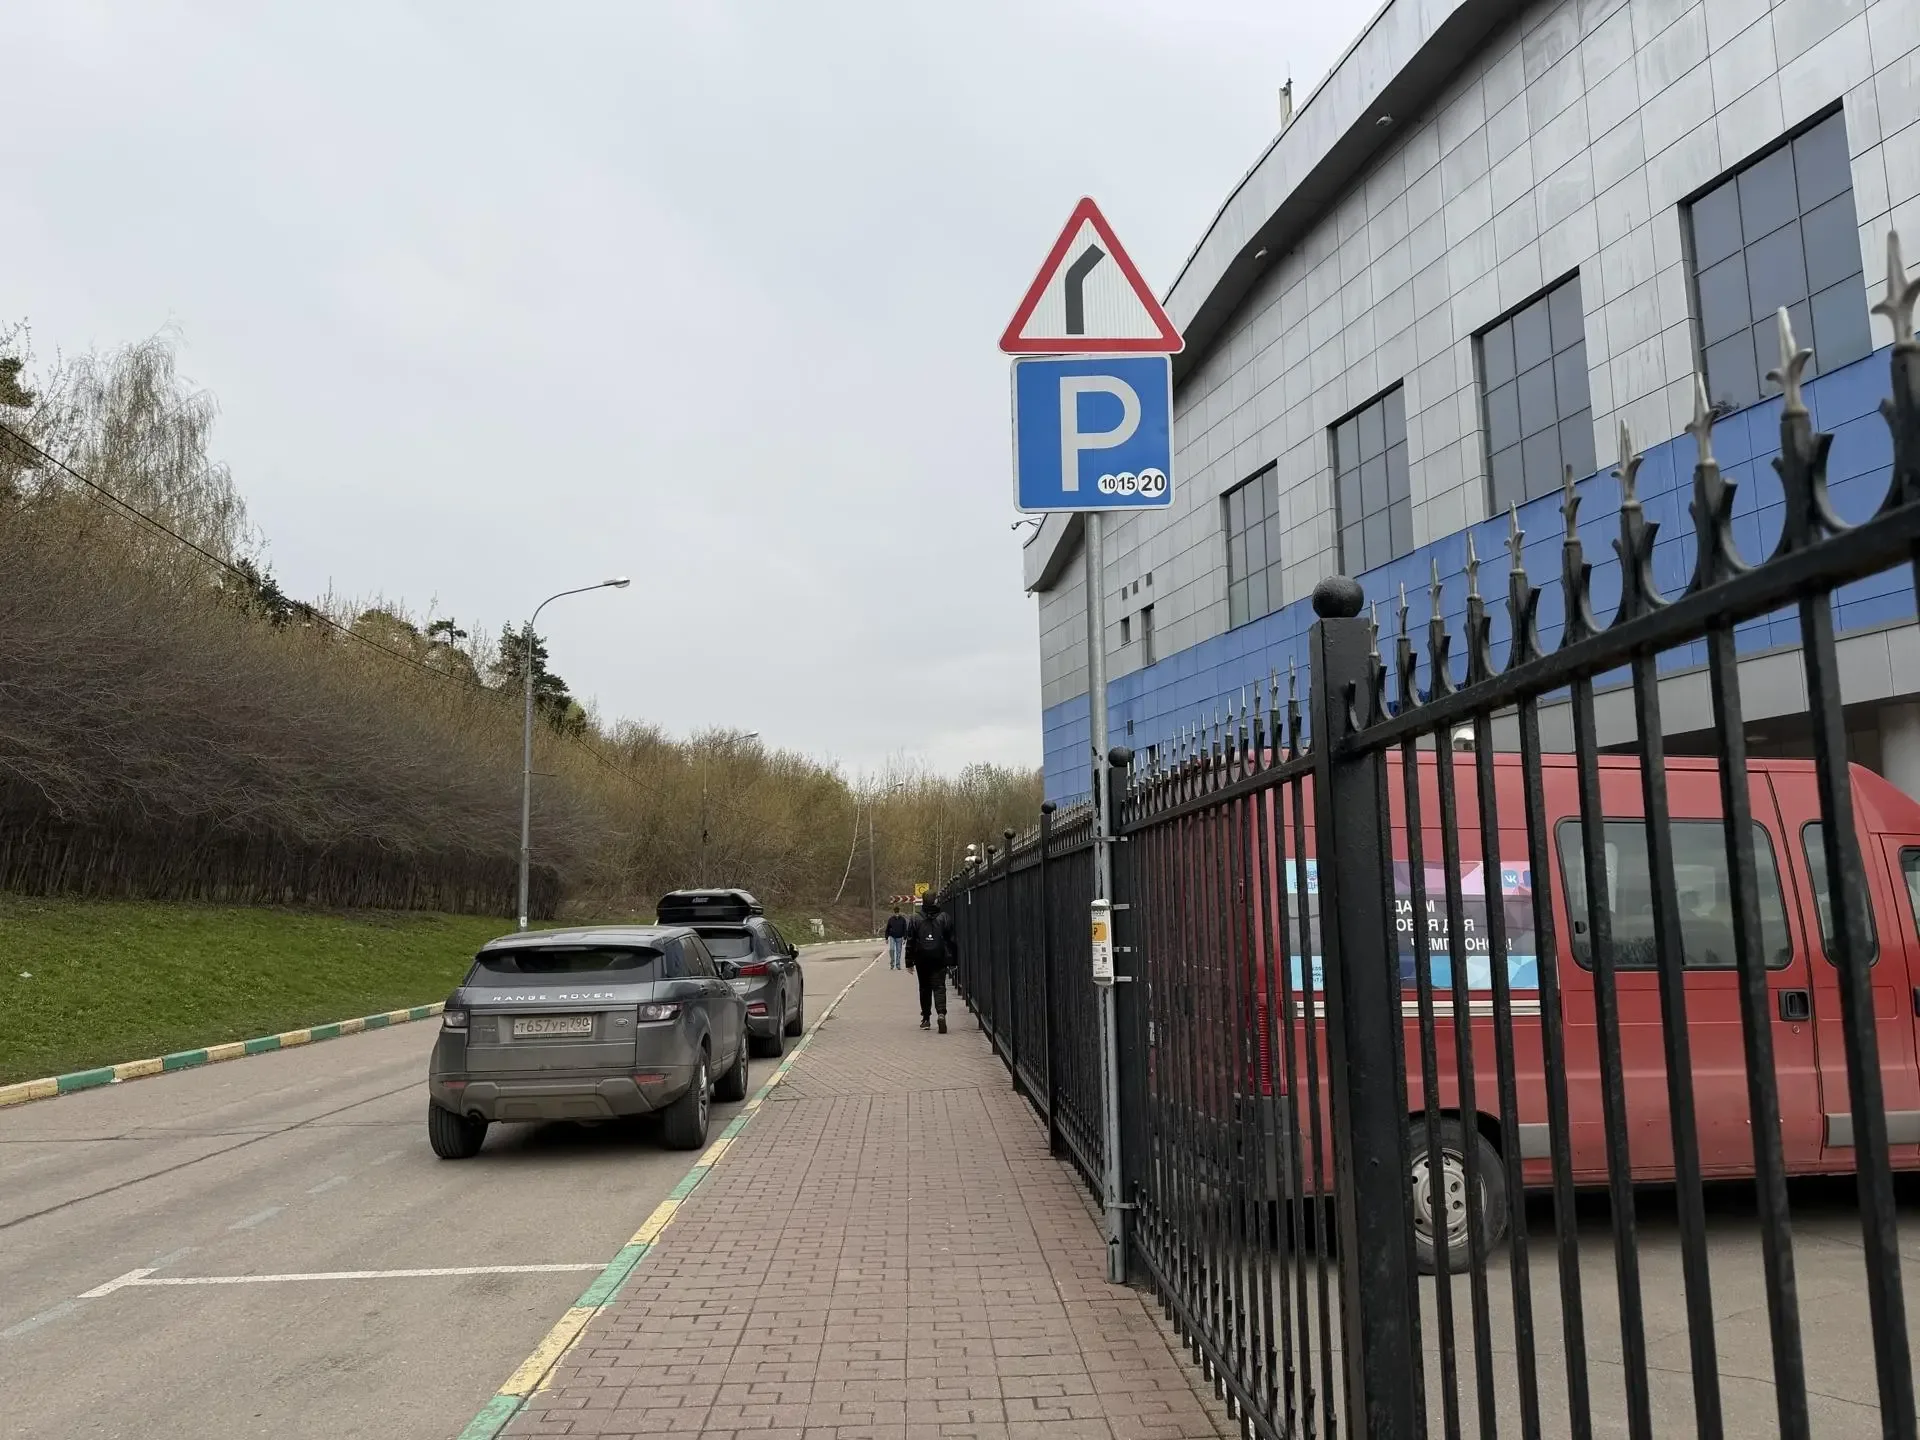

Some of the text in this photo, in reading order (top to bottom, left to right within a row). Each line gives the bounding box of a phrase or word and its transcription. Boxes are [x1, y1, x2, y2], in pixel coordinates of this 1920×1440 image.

[1060, 375, 1142, 492] P
[1101, 474, 1166, 492] 10 15 20
[559, 992, 616, 1000] ROVER
